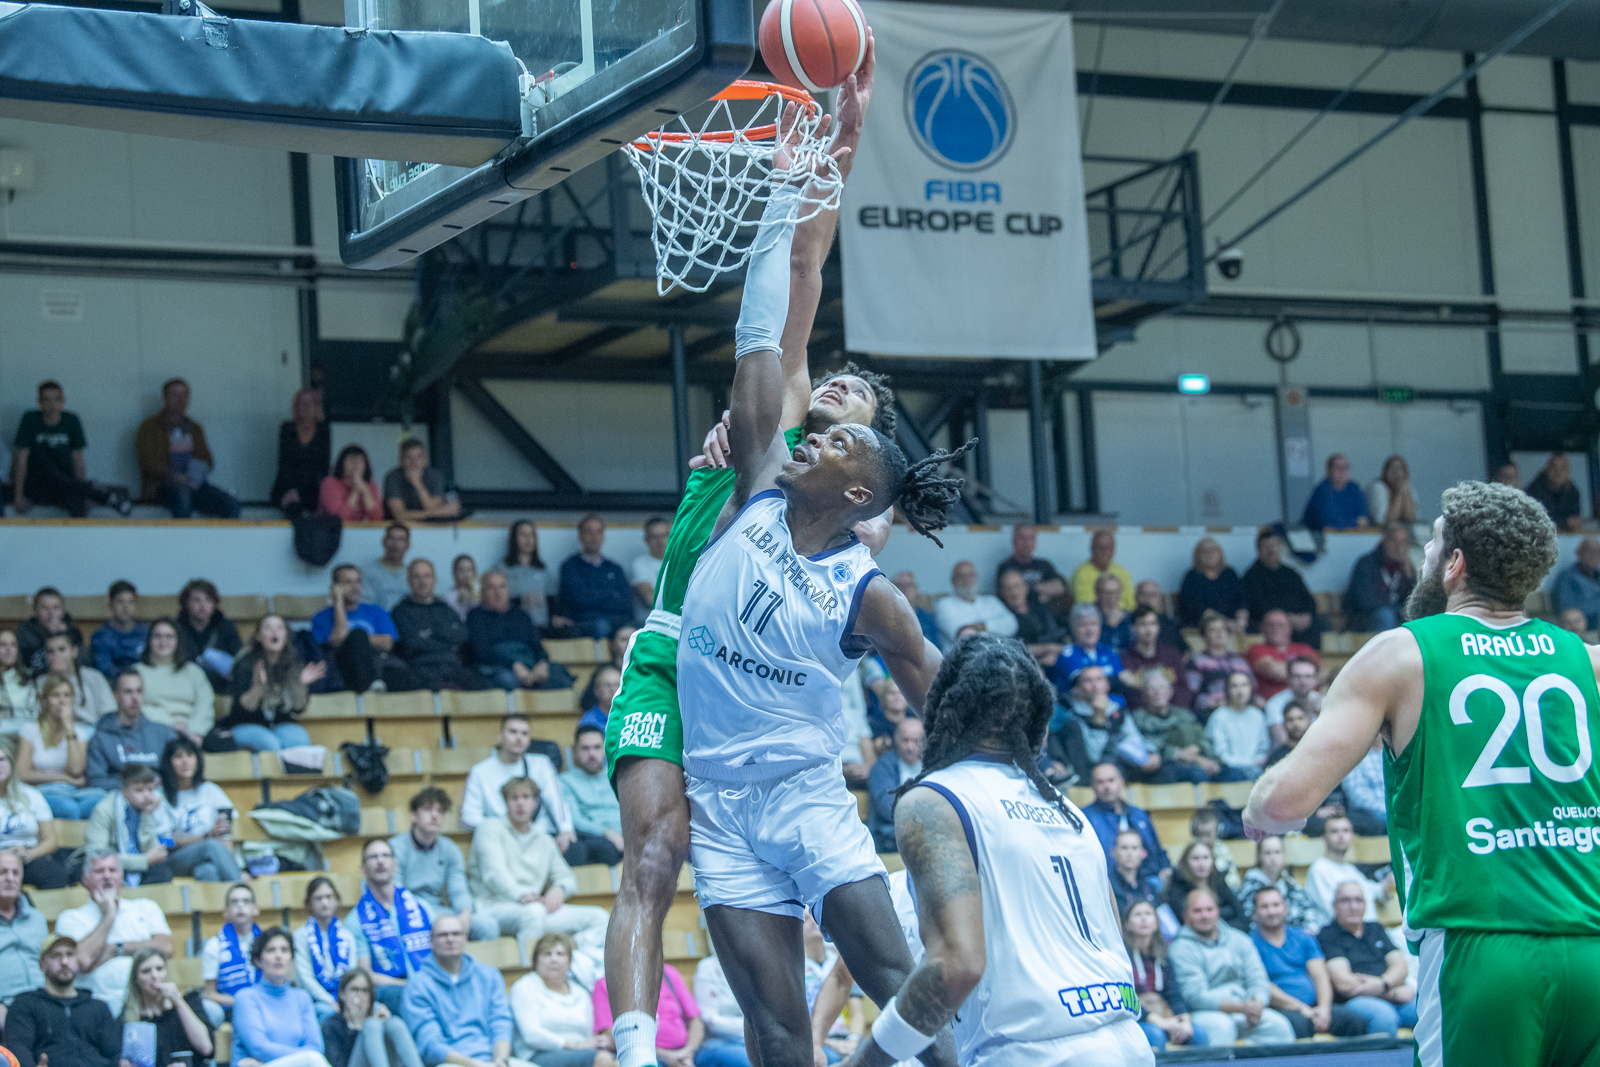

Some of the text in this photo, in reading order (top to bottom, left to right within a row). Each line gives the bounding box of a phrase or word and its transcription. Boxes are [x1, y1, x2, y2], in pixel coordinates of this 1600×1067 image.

[925, 179, 1002, 204] FIBA
[858, 206, 1063, 236] EUROPE CUP
[741, 522, 780, 559] ALBA
[739, 579, 784, 636] 11
[1460, 631, 1556, 656] ARAÚJO
[715, 645, 808, 687] ARCONIC
[620, 722, 665, 737] QUILI
[623, 711, 667, 726] TRAN
[1448, 673, 1592, 788] 20
[618, 733, 664, 749] DADE
[1050, 855, 1101, 952] 1
